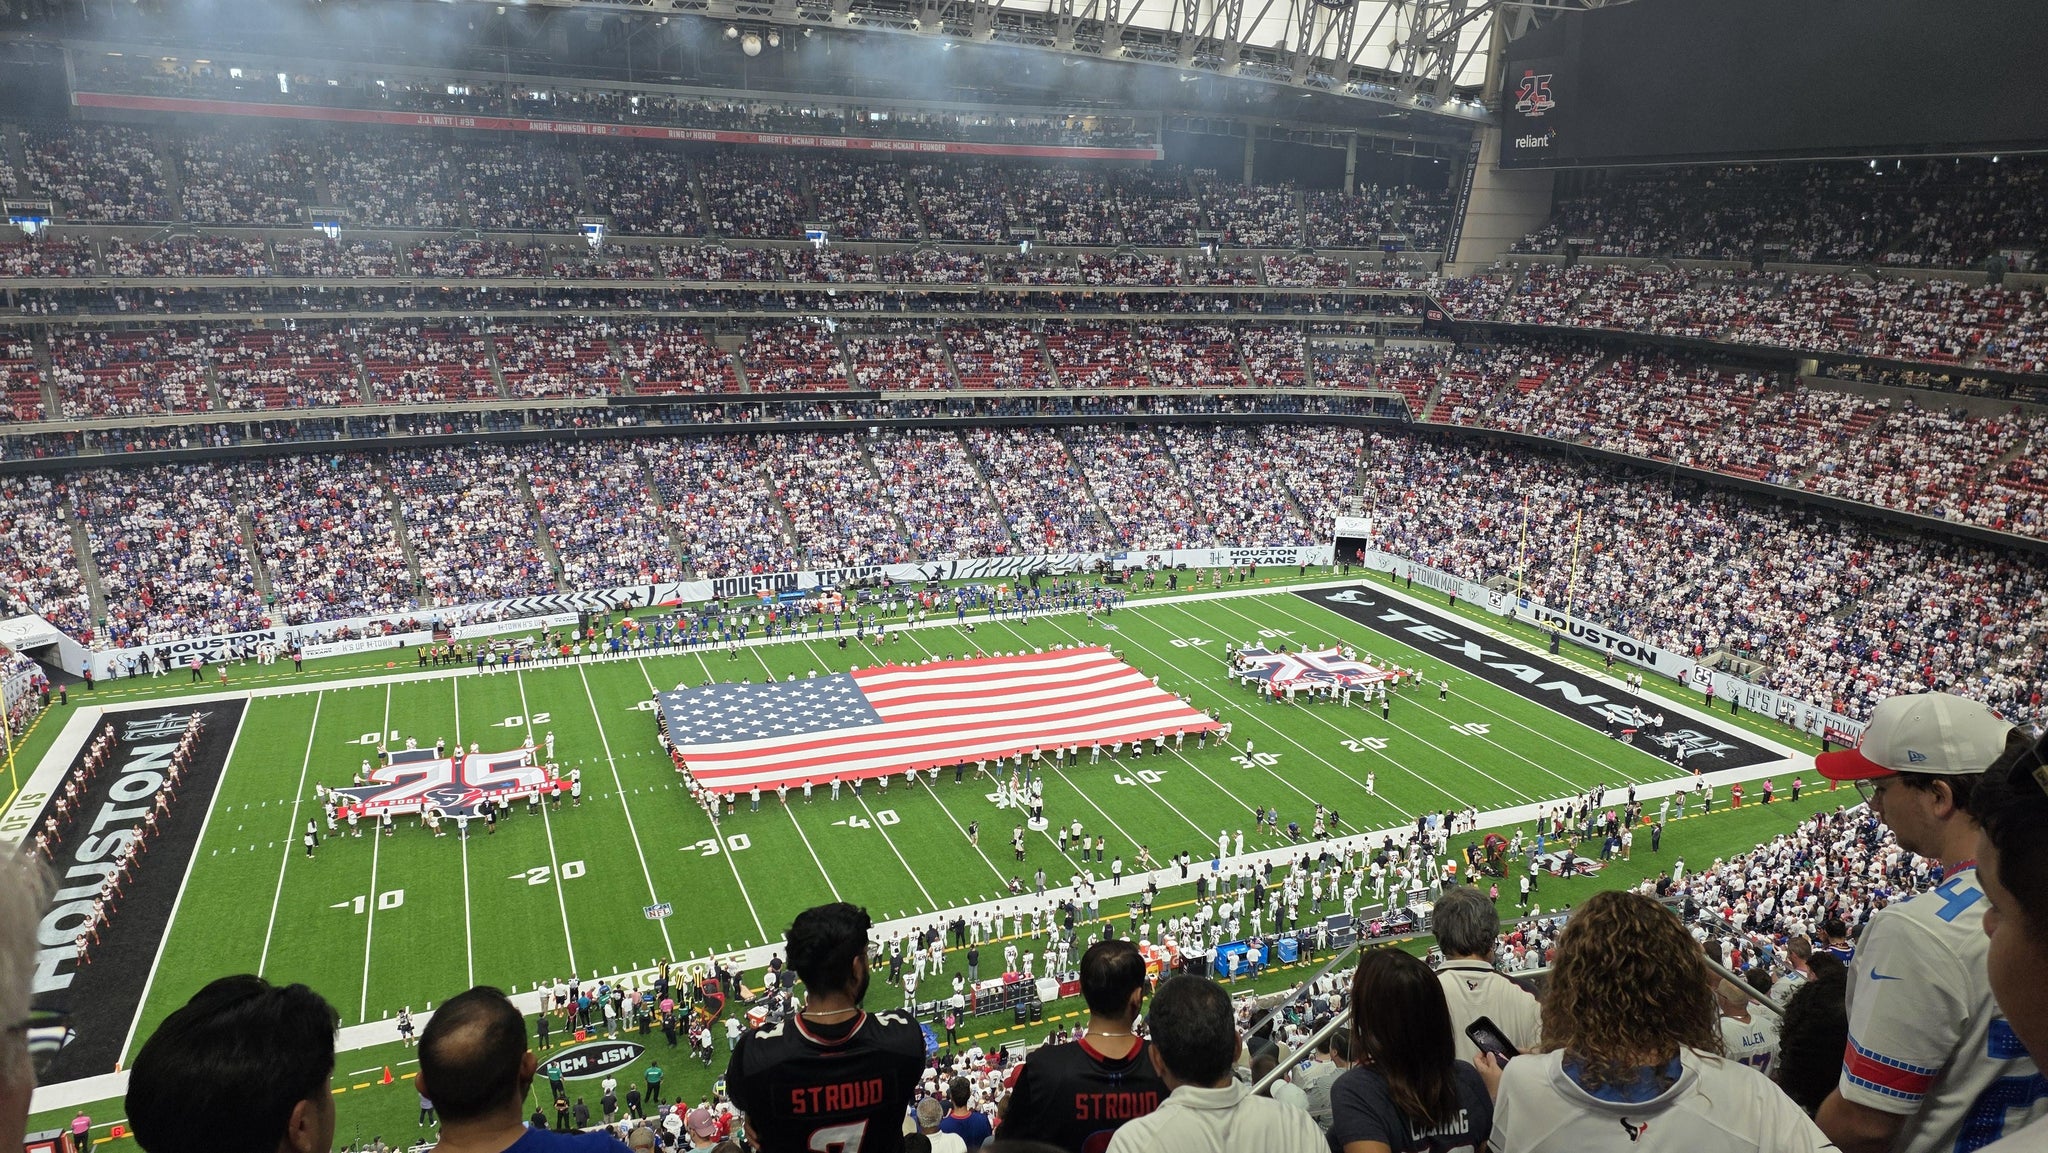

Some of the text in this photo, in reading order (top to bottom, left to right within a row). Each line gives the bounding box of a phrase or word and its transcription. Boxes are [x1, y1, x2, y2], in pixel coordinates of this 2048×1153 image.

[1519, 73, 1553, 103] 25
[417, 116, 475, 126] J.J. WATT #99
[529, 122, 606, 134] ANDRE JOHNSON #80
[668, 129, 685, 138] RING
[693, 130, 717, 140] HONOR
[758, 135, 782, 144] ROBERT
[792, 136, 815, 146] MCNAIR
[819, 137, 847, 147] FOUNDER
[1515, 133, 1549, 149] reliant
[870, 140, 892, 149] JANICE
[919, 142, 946, 151] FOUNDER
[1229, 548, 1298, 557] HOUSTON
[1230, 556, 1297, 566] TEXANS
[713, 573, 798, 598] HOUSTON
[1440, 575, 1464, 595] MADE
[1490, 593, 1502, 607] 25
[25, 638, 49, 647] Chevron
[154, 631, 275, 655] HOUSTON
[1535, 609, 1657, 666] HOUSTON
[1377, 607, 1647, 727] TEXANS
[1695, 668, 1712, 686] 25
[1340, 737, 1388, 752] 20
[368, 745, 549, 802] 25
[1114, 769, 1162, 786] 40
[1, 793, 47, 831] OF US
[849, 809, 900, 829] 40
[696, 833, 751, 857] 30
[32, 743, 179, 994] HOUSTON
[527, 860, 586, 886] 20
[352, 889, 405, 914] 10
[1742, 1031, 1765, 1048] ALLEN
[597, 1046, 635, 1065] JSM
[792, 1078, 883, 1114] STROUD
[1075, 1090, 1159, 1121] STROUD
